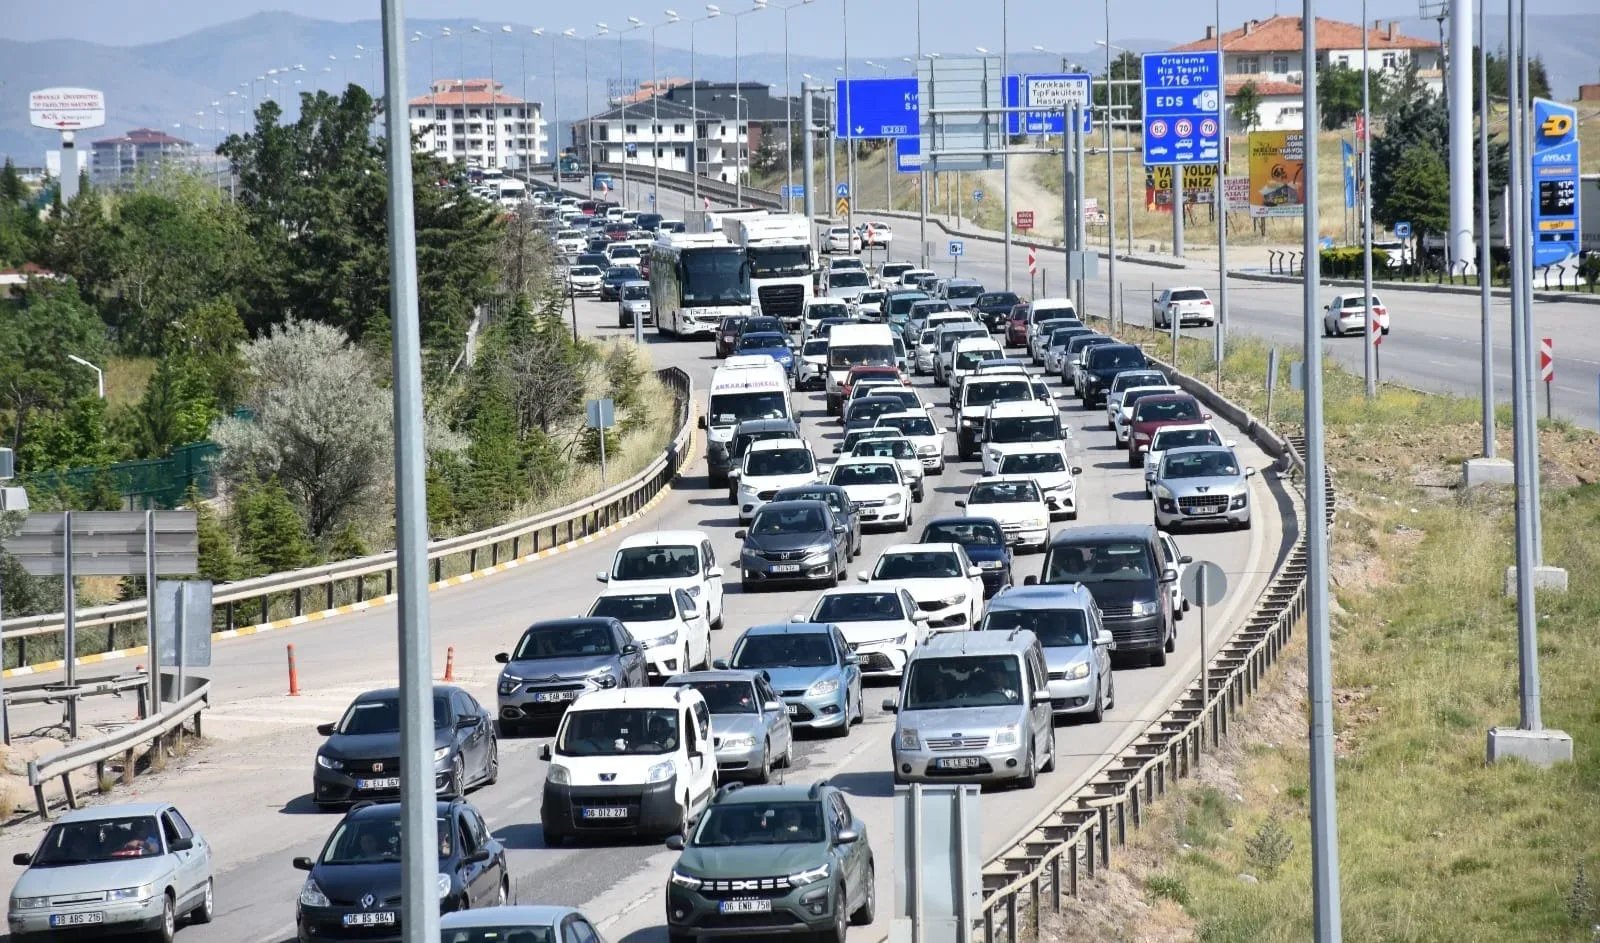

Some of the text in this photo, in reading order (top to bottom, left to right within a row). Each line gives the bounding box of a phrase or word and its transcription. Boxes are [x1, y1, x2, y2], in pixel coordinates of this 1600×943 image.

[1161, 57, 1205, 65] Ortalama
[1176, 65, 1209, 74] Tespiti
[1160, 75, 1190, 86] 1716
[1156, 96, 1184, 107] EDS
[1179, 124, 1189, 132] 70
[1204, 123, 1213, 132] 70
[1542, 153, 1571, 162] AYGAZ
[1157, 164, 1227, 178] YA YOLDA
[724, 902, 733, 911] 06
[56, 912, 102, 925] 38 ABS 216
[348, 914, 358, 924] 06
[374, 912, 394, 922] 9841
